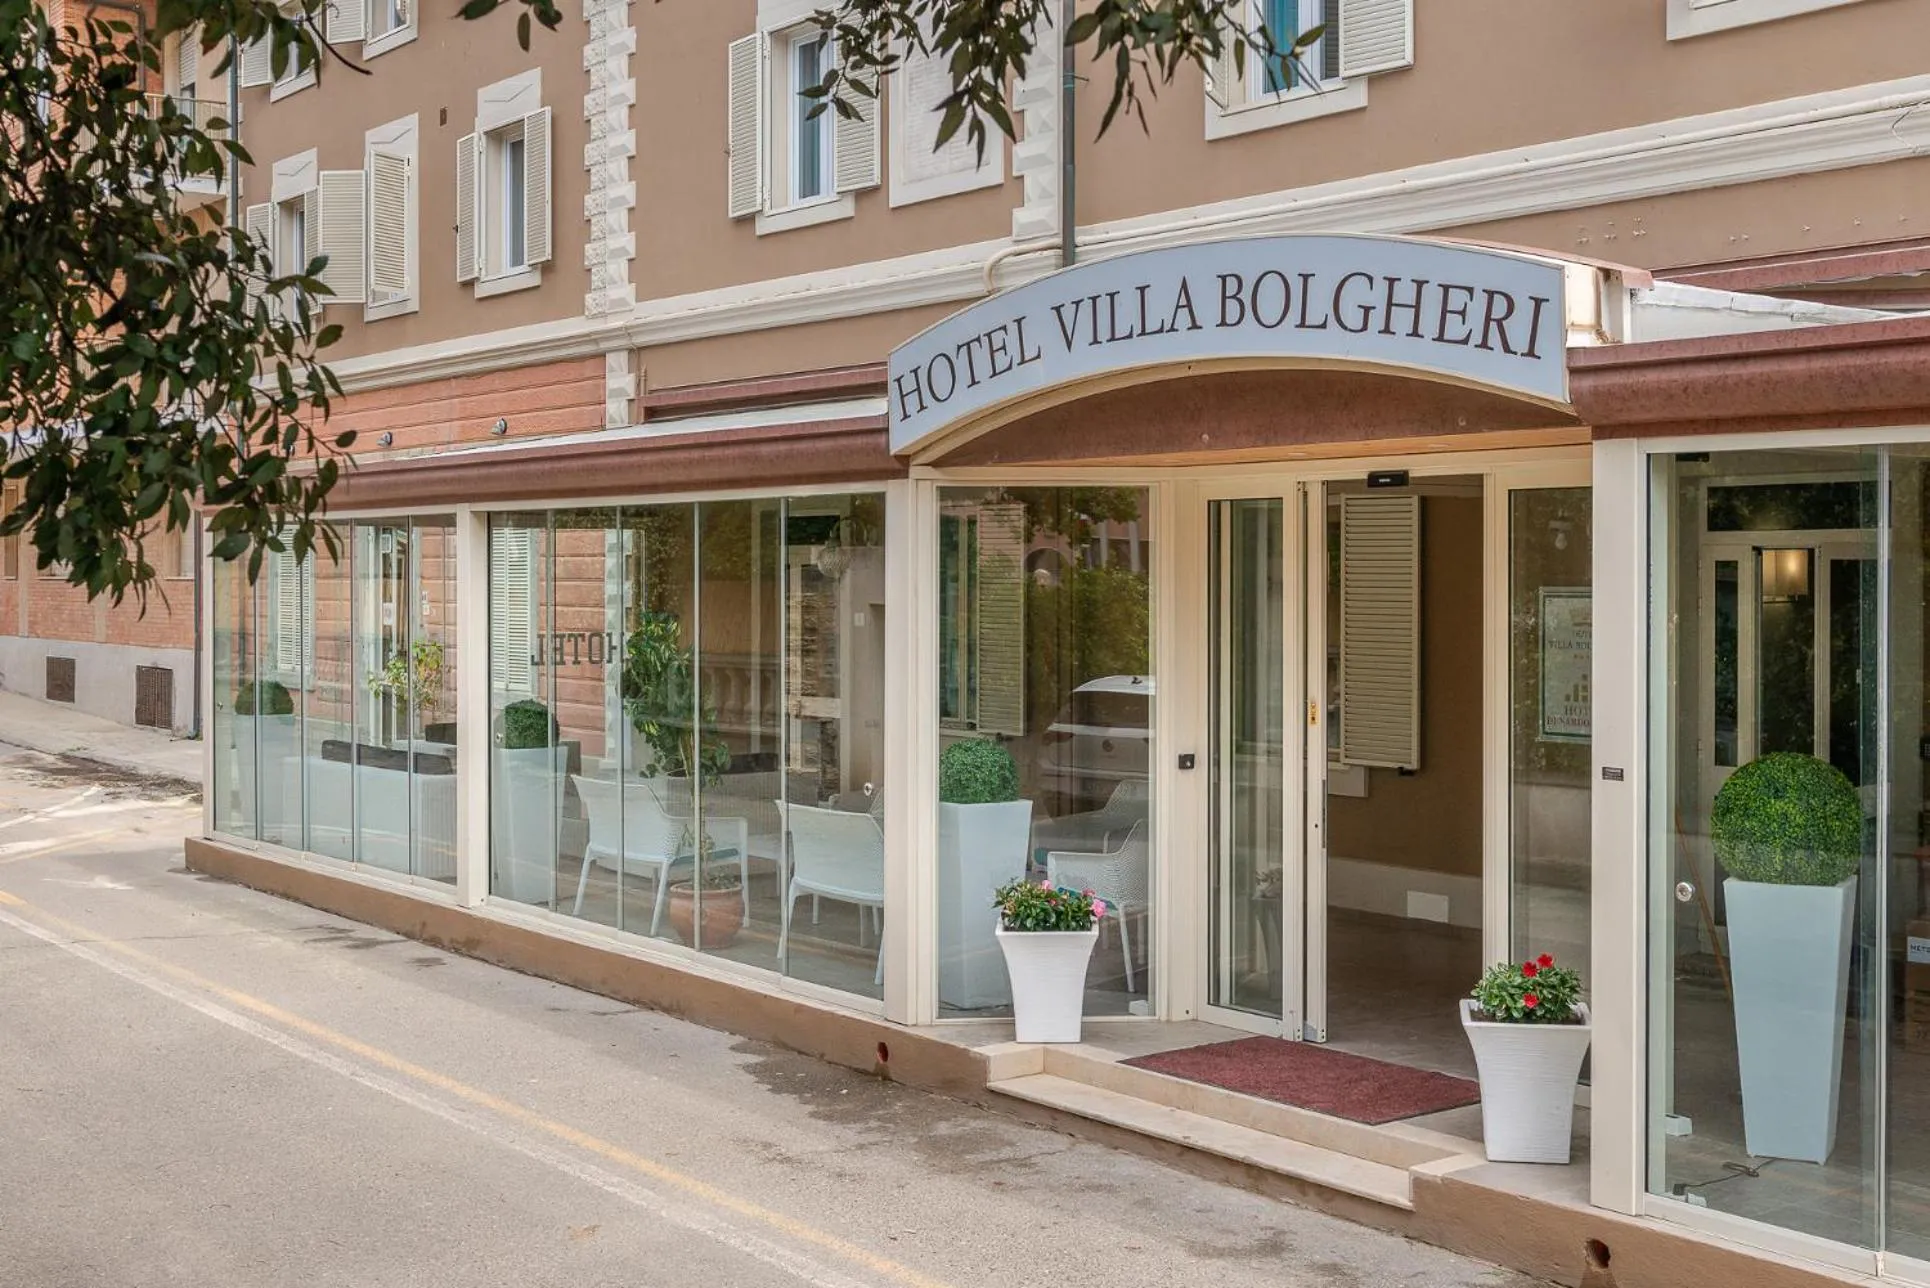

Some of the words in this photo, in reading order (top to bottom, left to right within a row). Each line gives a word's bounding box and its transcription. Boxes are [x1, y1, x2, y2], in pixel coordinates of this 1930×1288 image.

[893, 316, 1042, 423] HOTEL
[1050, 276, 1204, 353] VILLA
[1215, 270, 1550, 360] BOLGHERI
